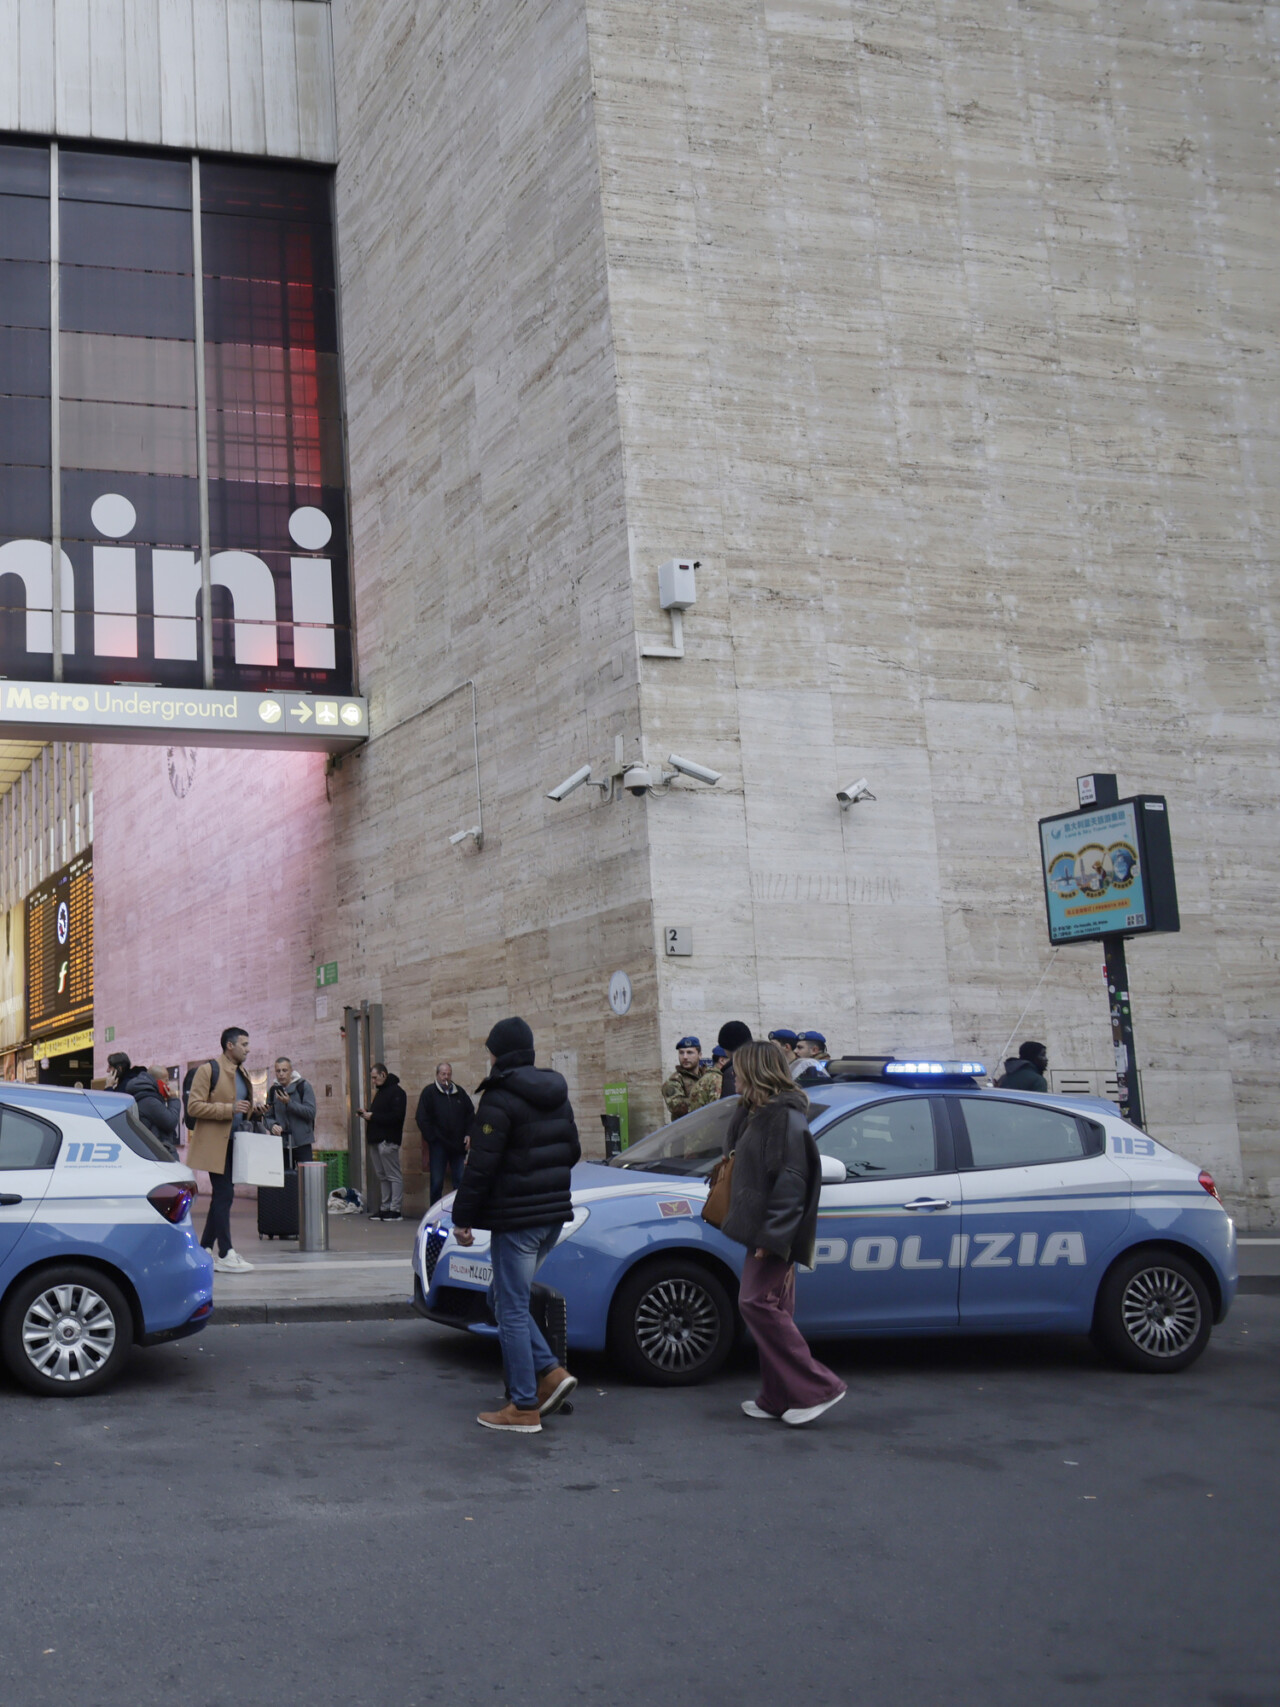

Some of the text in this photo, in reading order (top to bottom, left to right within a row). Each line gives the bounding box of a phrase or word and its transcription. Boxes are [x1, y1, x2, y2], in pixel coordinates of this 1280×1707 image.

[6, 687, 238, 720] Metro Underground
[669, 929, 677, 941] 2
[65, 1143, 122, 1162] 113
[1111, 1136, 1155, 1156] 113
[798, 1231, 1087, 1273] POLIZIA
